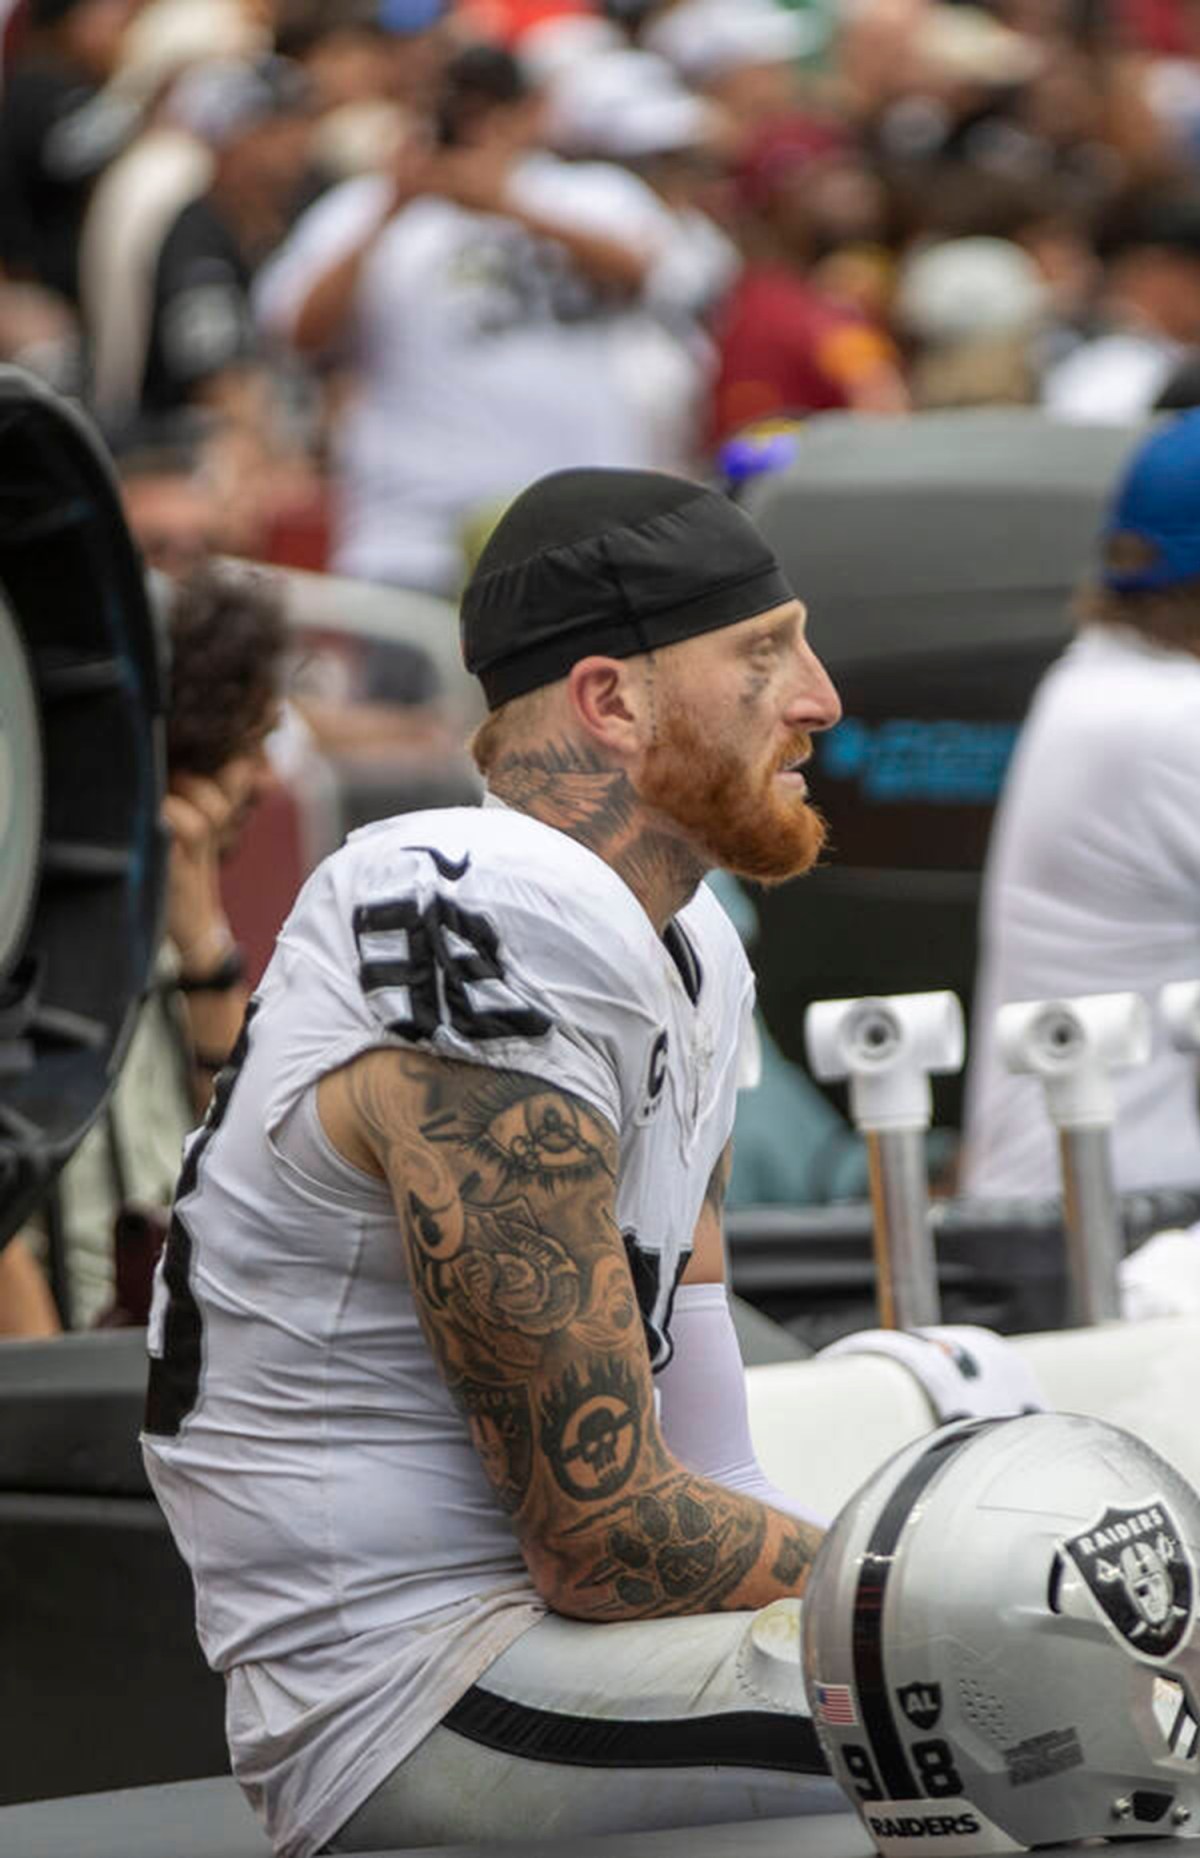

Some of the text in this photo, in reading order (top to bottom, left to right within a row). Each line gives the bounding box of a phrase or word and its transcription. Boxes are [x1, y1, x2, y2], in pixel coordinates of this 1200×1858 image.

[1078, 1508, 1164, 1555] RAIDERS
[906, 1691, 938, 1714] AL
[869, 1813, 981, 1838] RAIDERS
